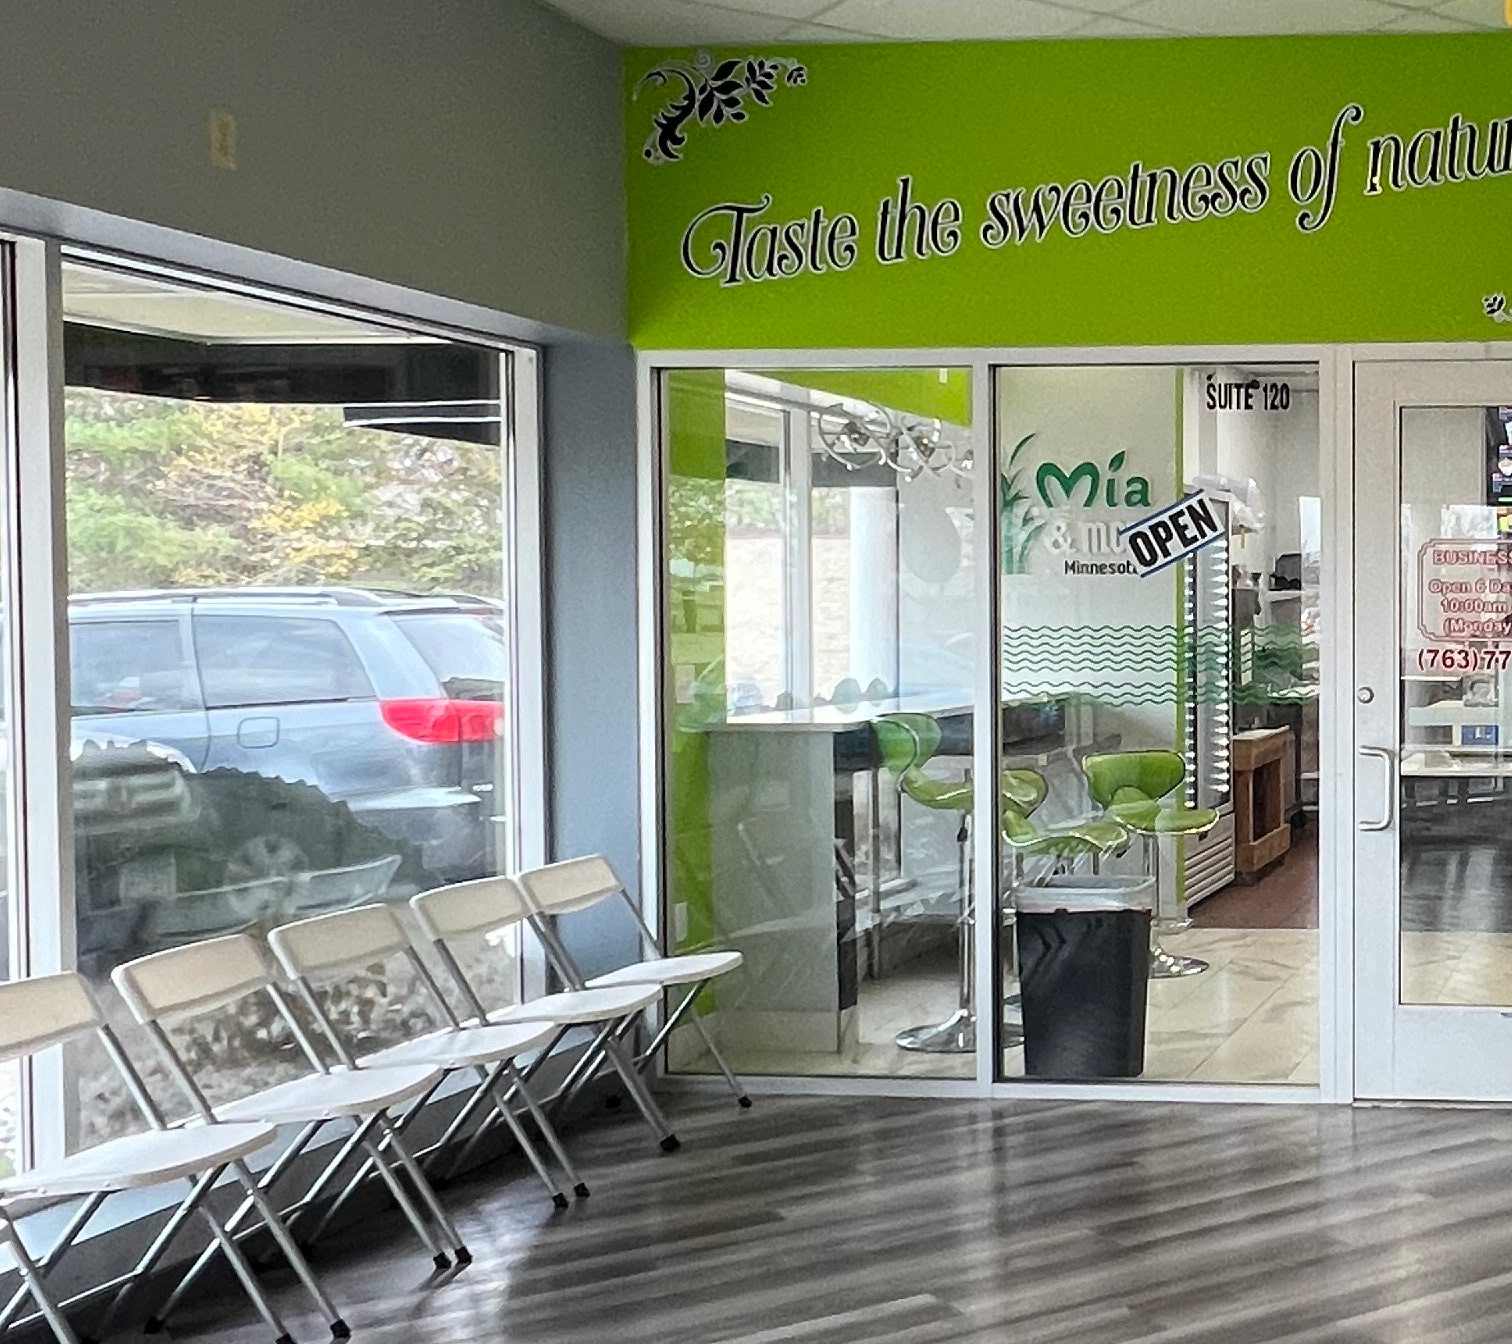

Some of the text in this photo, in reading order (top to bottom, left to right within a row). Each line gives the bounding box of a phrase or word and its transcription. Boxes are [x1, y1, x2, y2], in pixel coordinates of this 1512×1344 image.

[682, 195, 858, 288] Taste
[876, 175, 963, 265] the
[981, 152, 1271, 248] sweetness
[1288, 102, 1365, 234] of
[1205, 382, 1292, 411] SUITE 120
[1043, 520, 1076, 555] &
[1128, 498, 1218, 569] OPEN
[1428, 578, 1472, 596] Open
[1474, 578, 1487, 594] 6
[1440, 598, 1507, 613] 10:00am
[1443, 617, 1512, 635] (Monday
